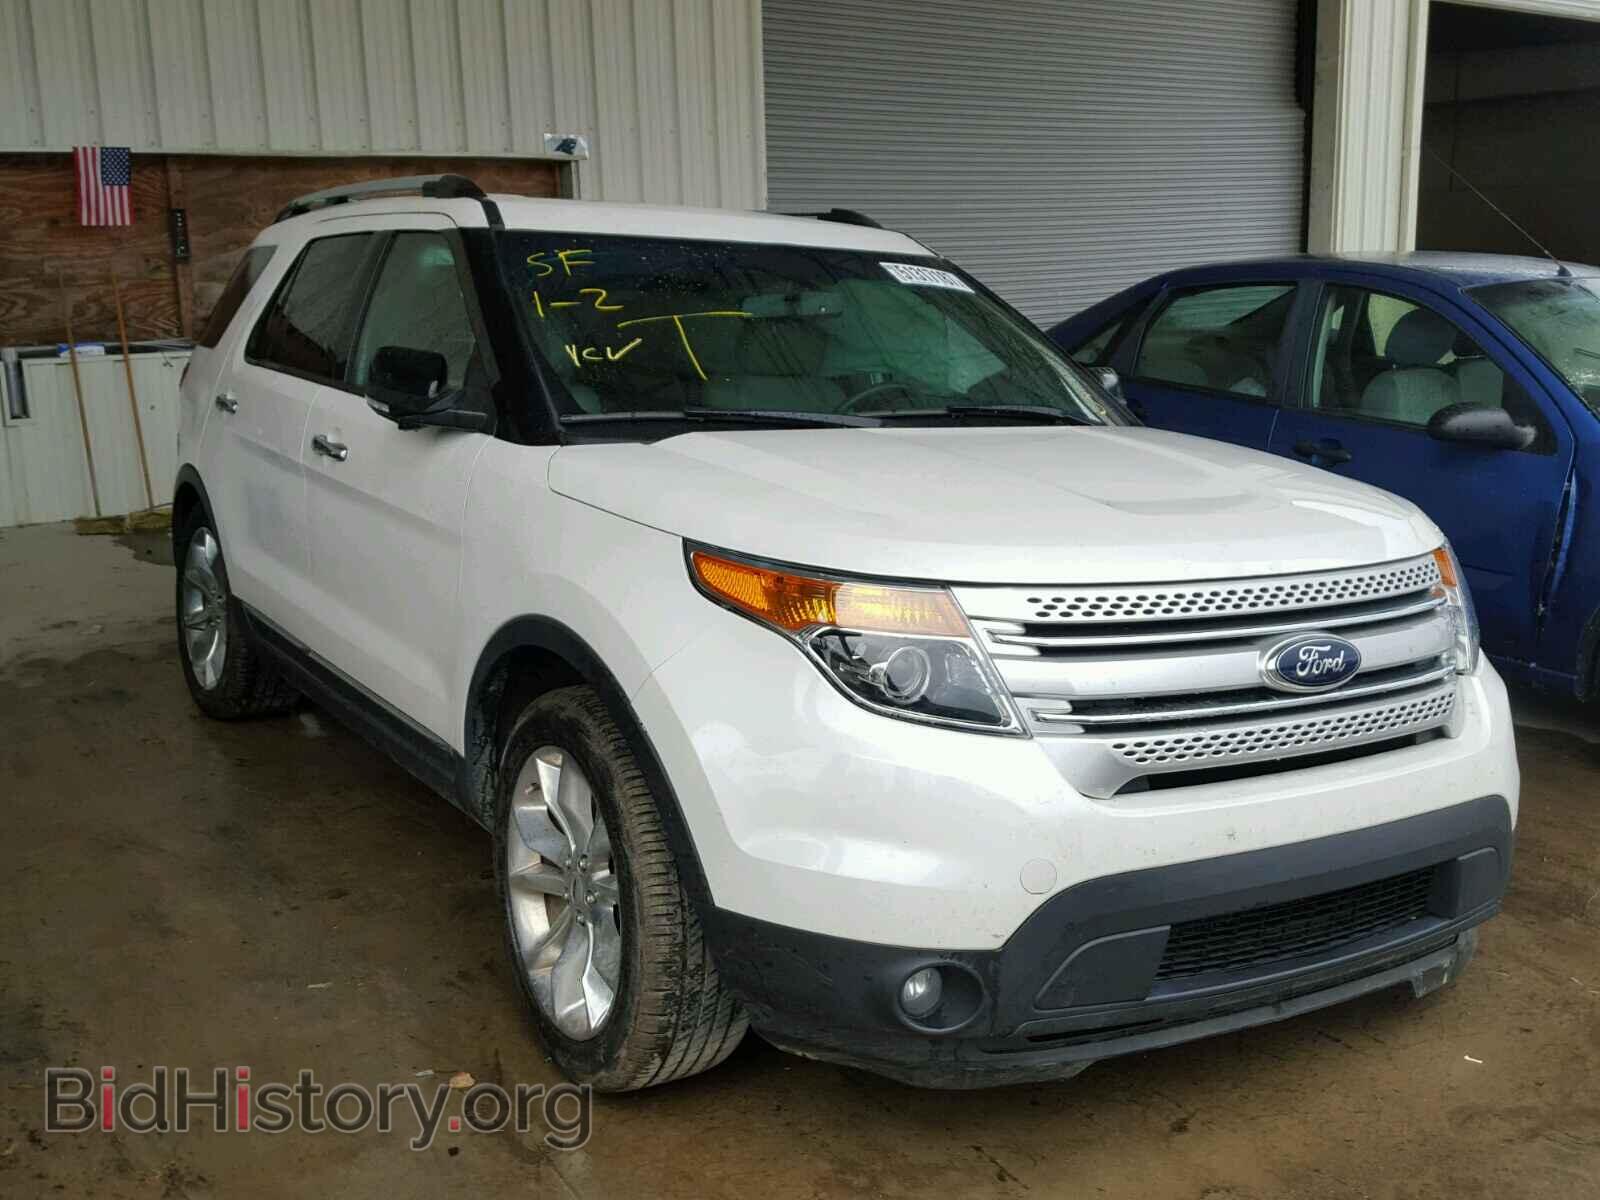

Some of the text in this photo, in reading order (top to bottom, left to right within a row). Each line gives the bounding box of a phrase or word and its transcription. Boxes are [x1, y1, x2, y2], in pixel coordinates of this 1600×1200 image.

[527, 249, 597, 276] SF
[533, 288, 624, 318] 1-2
[1296, 644, 1347, 677] Ford
